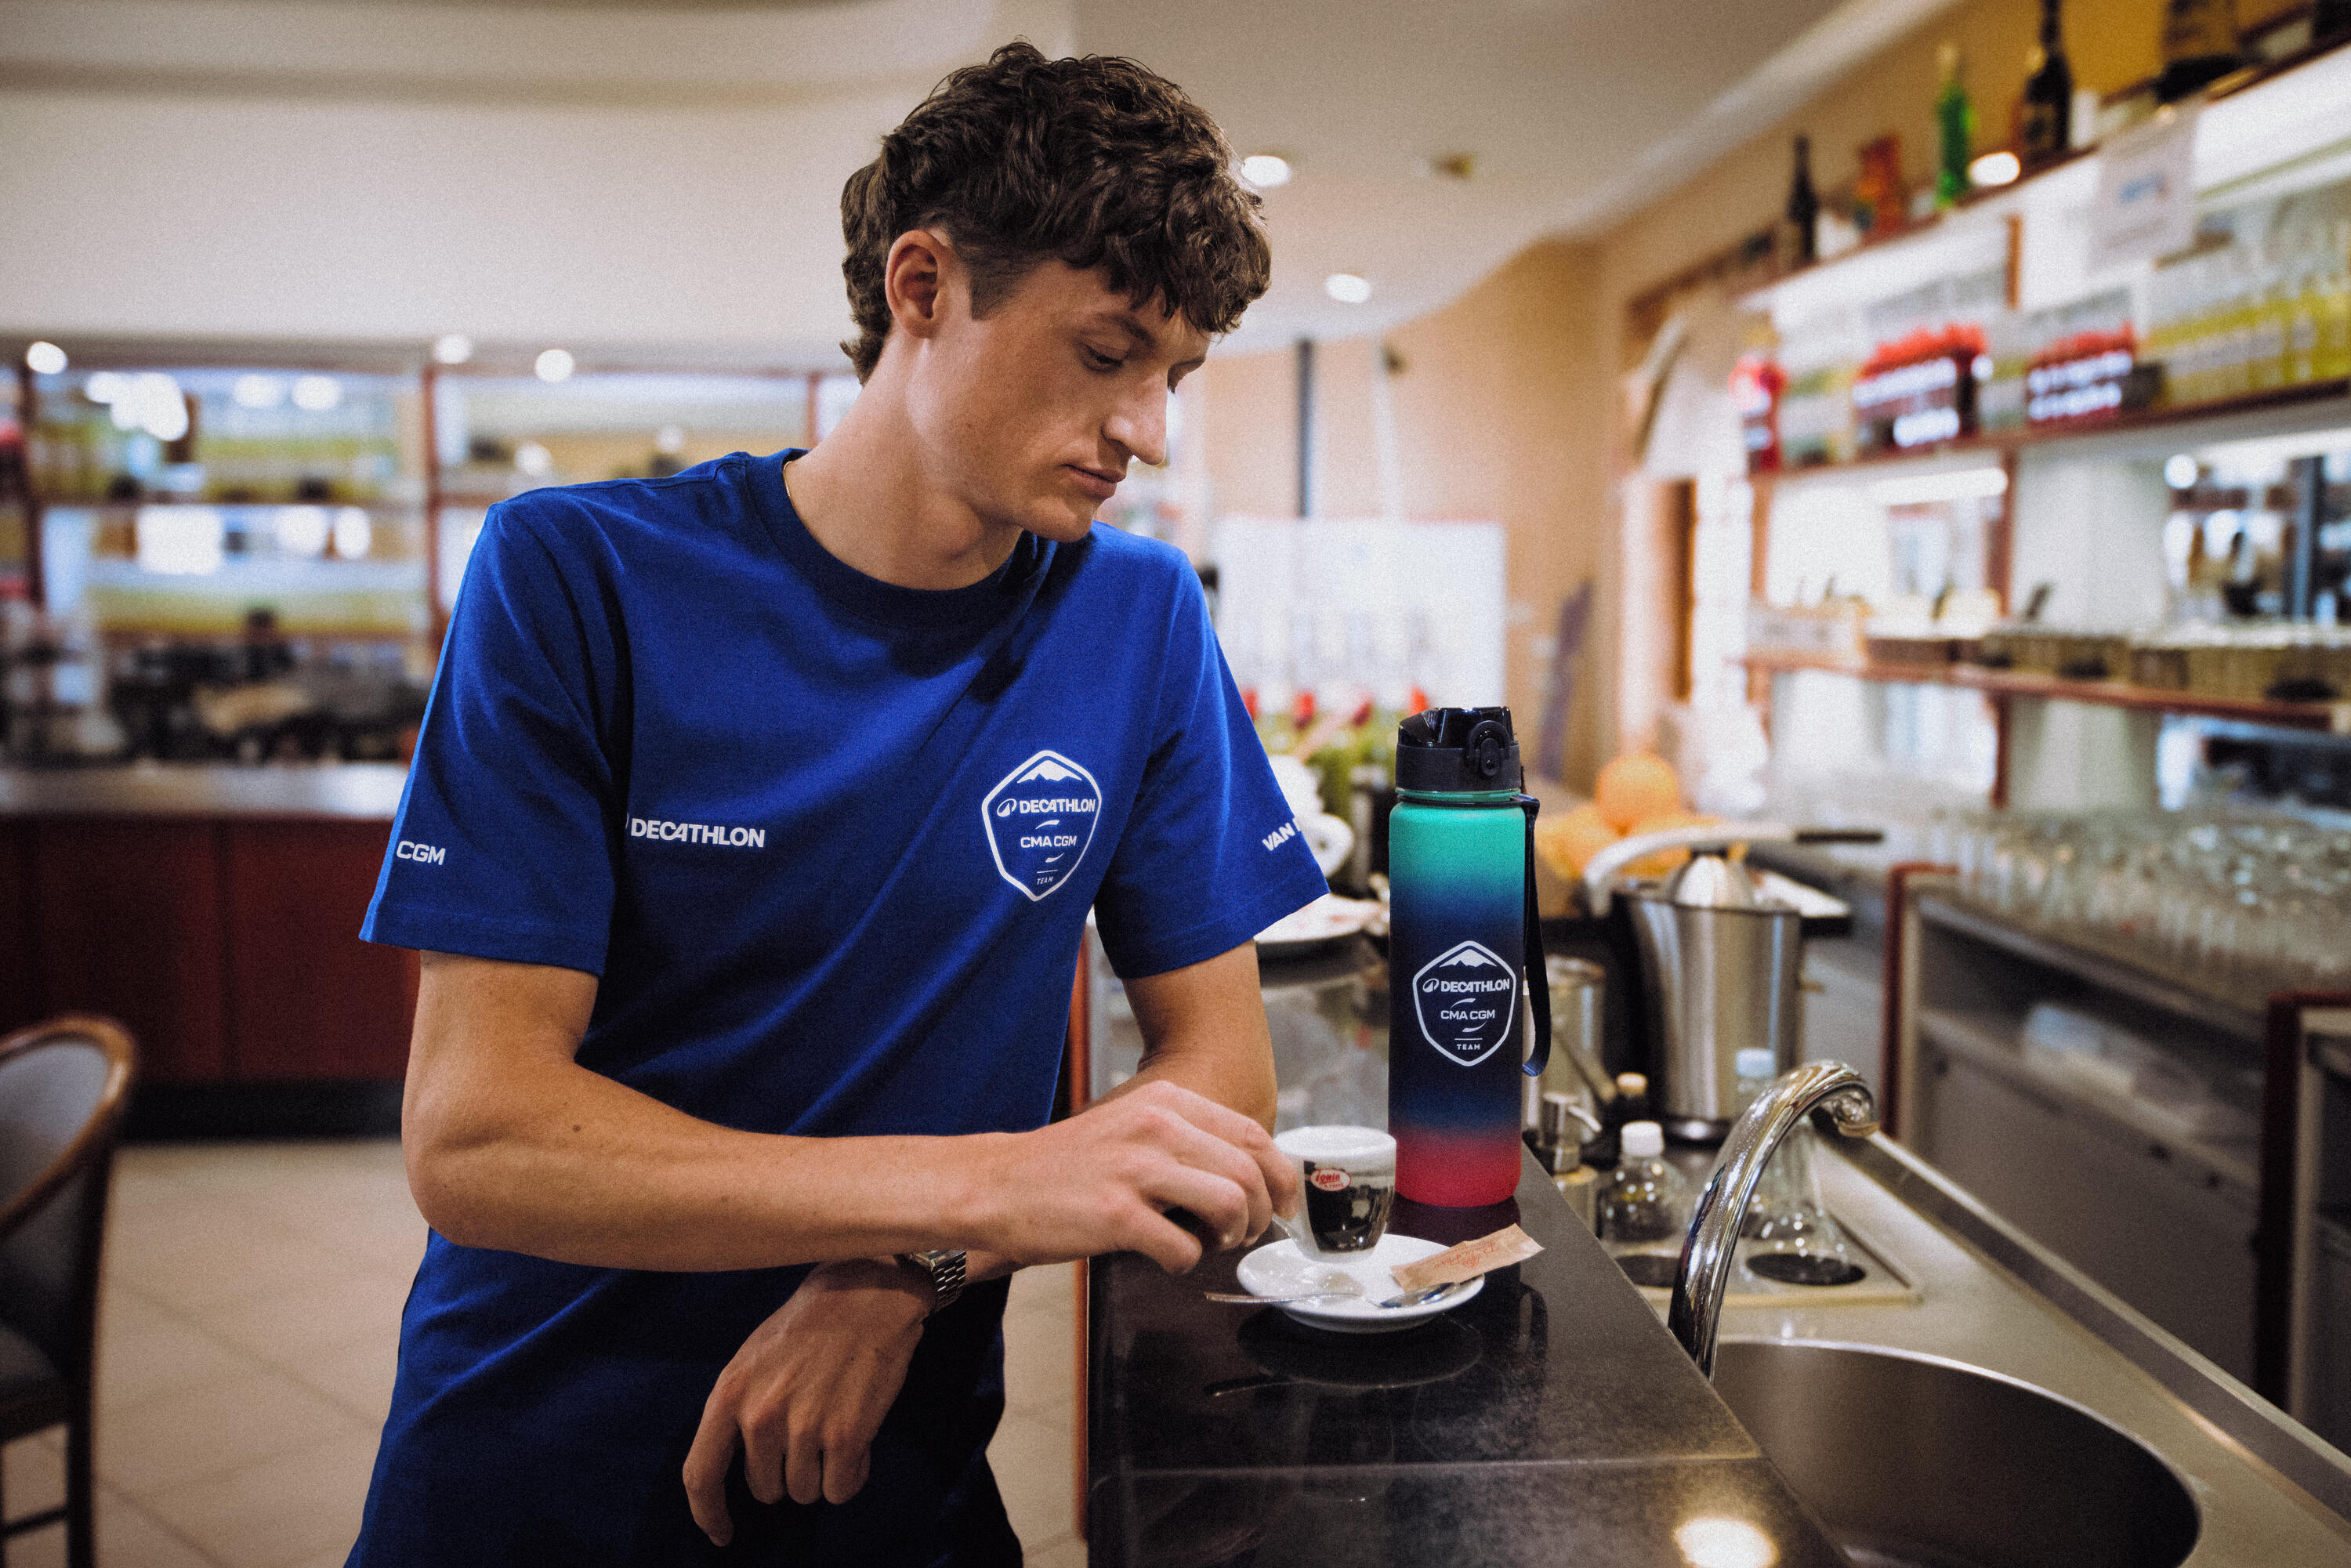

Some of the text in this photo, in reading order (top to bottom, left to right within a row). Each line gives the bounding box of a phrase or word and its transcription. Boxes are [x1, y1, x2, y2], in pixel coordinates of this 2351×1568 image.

[1020, 798, 1096, 813] DECATHLON
[631, 818, 765, 848] DECATHLON
[1262, 822, 1295, 851] VAN
[1020, 835, 1077, 848] CMA CGM
[397, 840, 446, 865] CGM
[1037, 876, 1053, 885] TEAM
[1440, 979, 1509, 993] DECATHLON
[1440, 1009, 1495, 1019] CMA CGM
